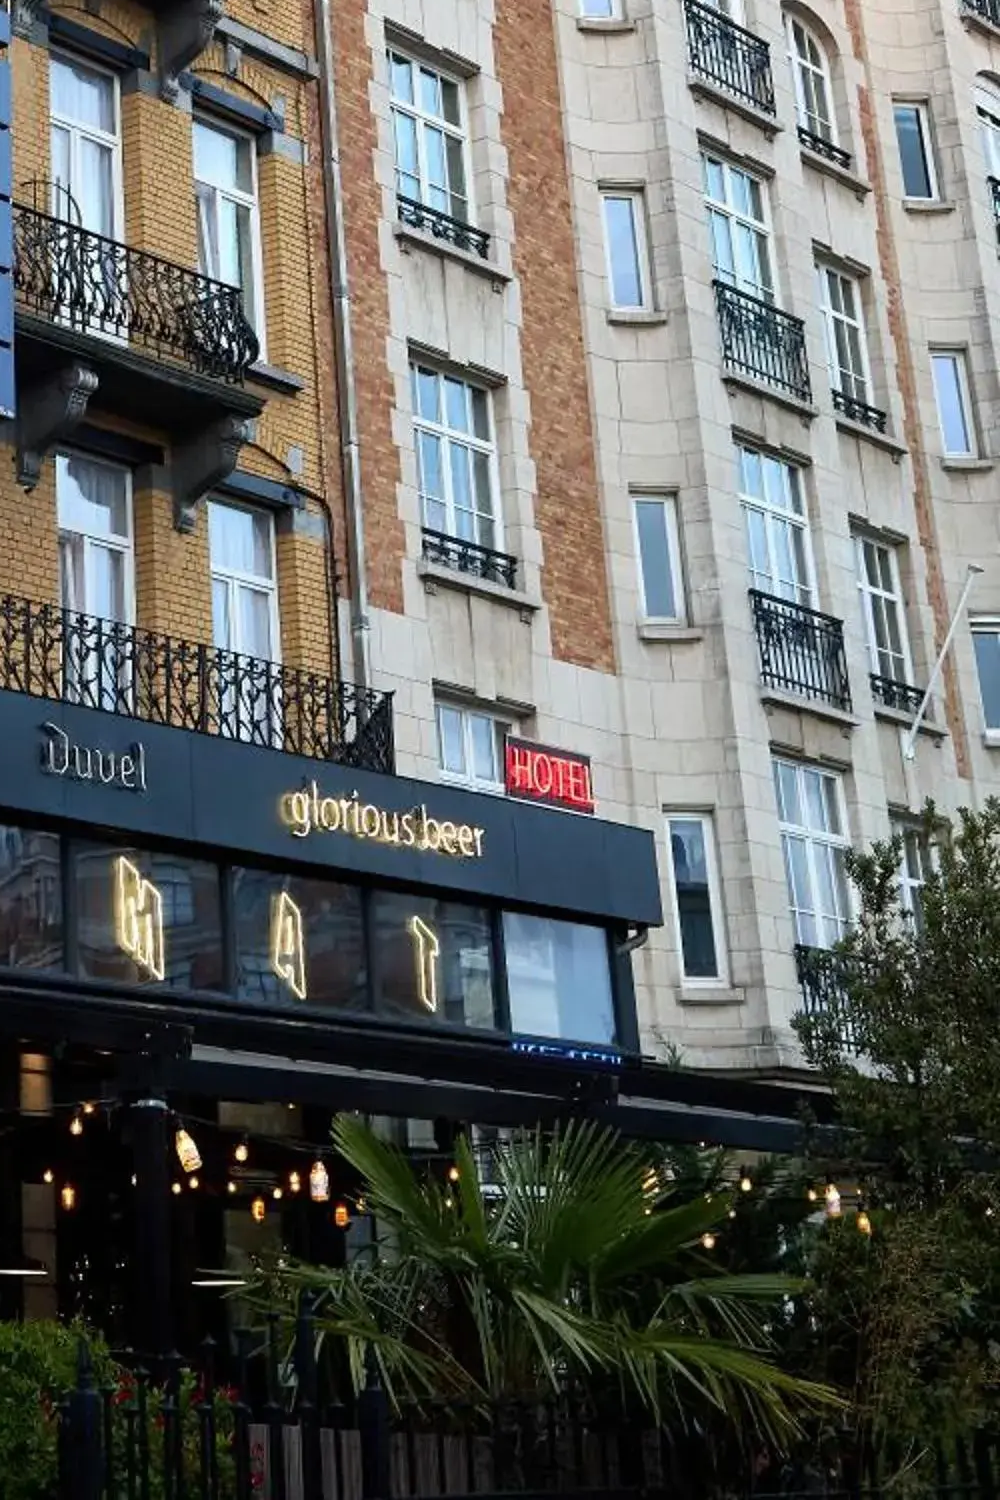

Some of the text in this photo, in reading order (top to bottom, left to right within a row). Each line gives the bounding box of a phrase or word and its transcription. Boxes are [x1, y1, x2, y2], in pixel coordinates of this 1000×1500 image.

[43, 720, 148, 792] Duvel
[512, 746, 600, 804] HOTEL
[288, 779, 486, 858] glorious beer
